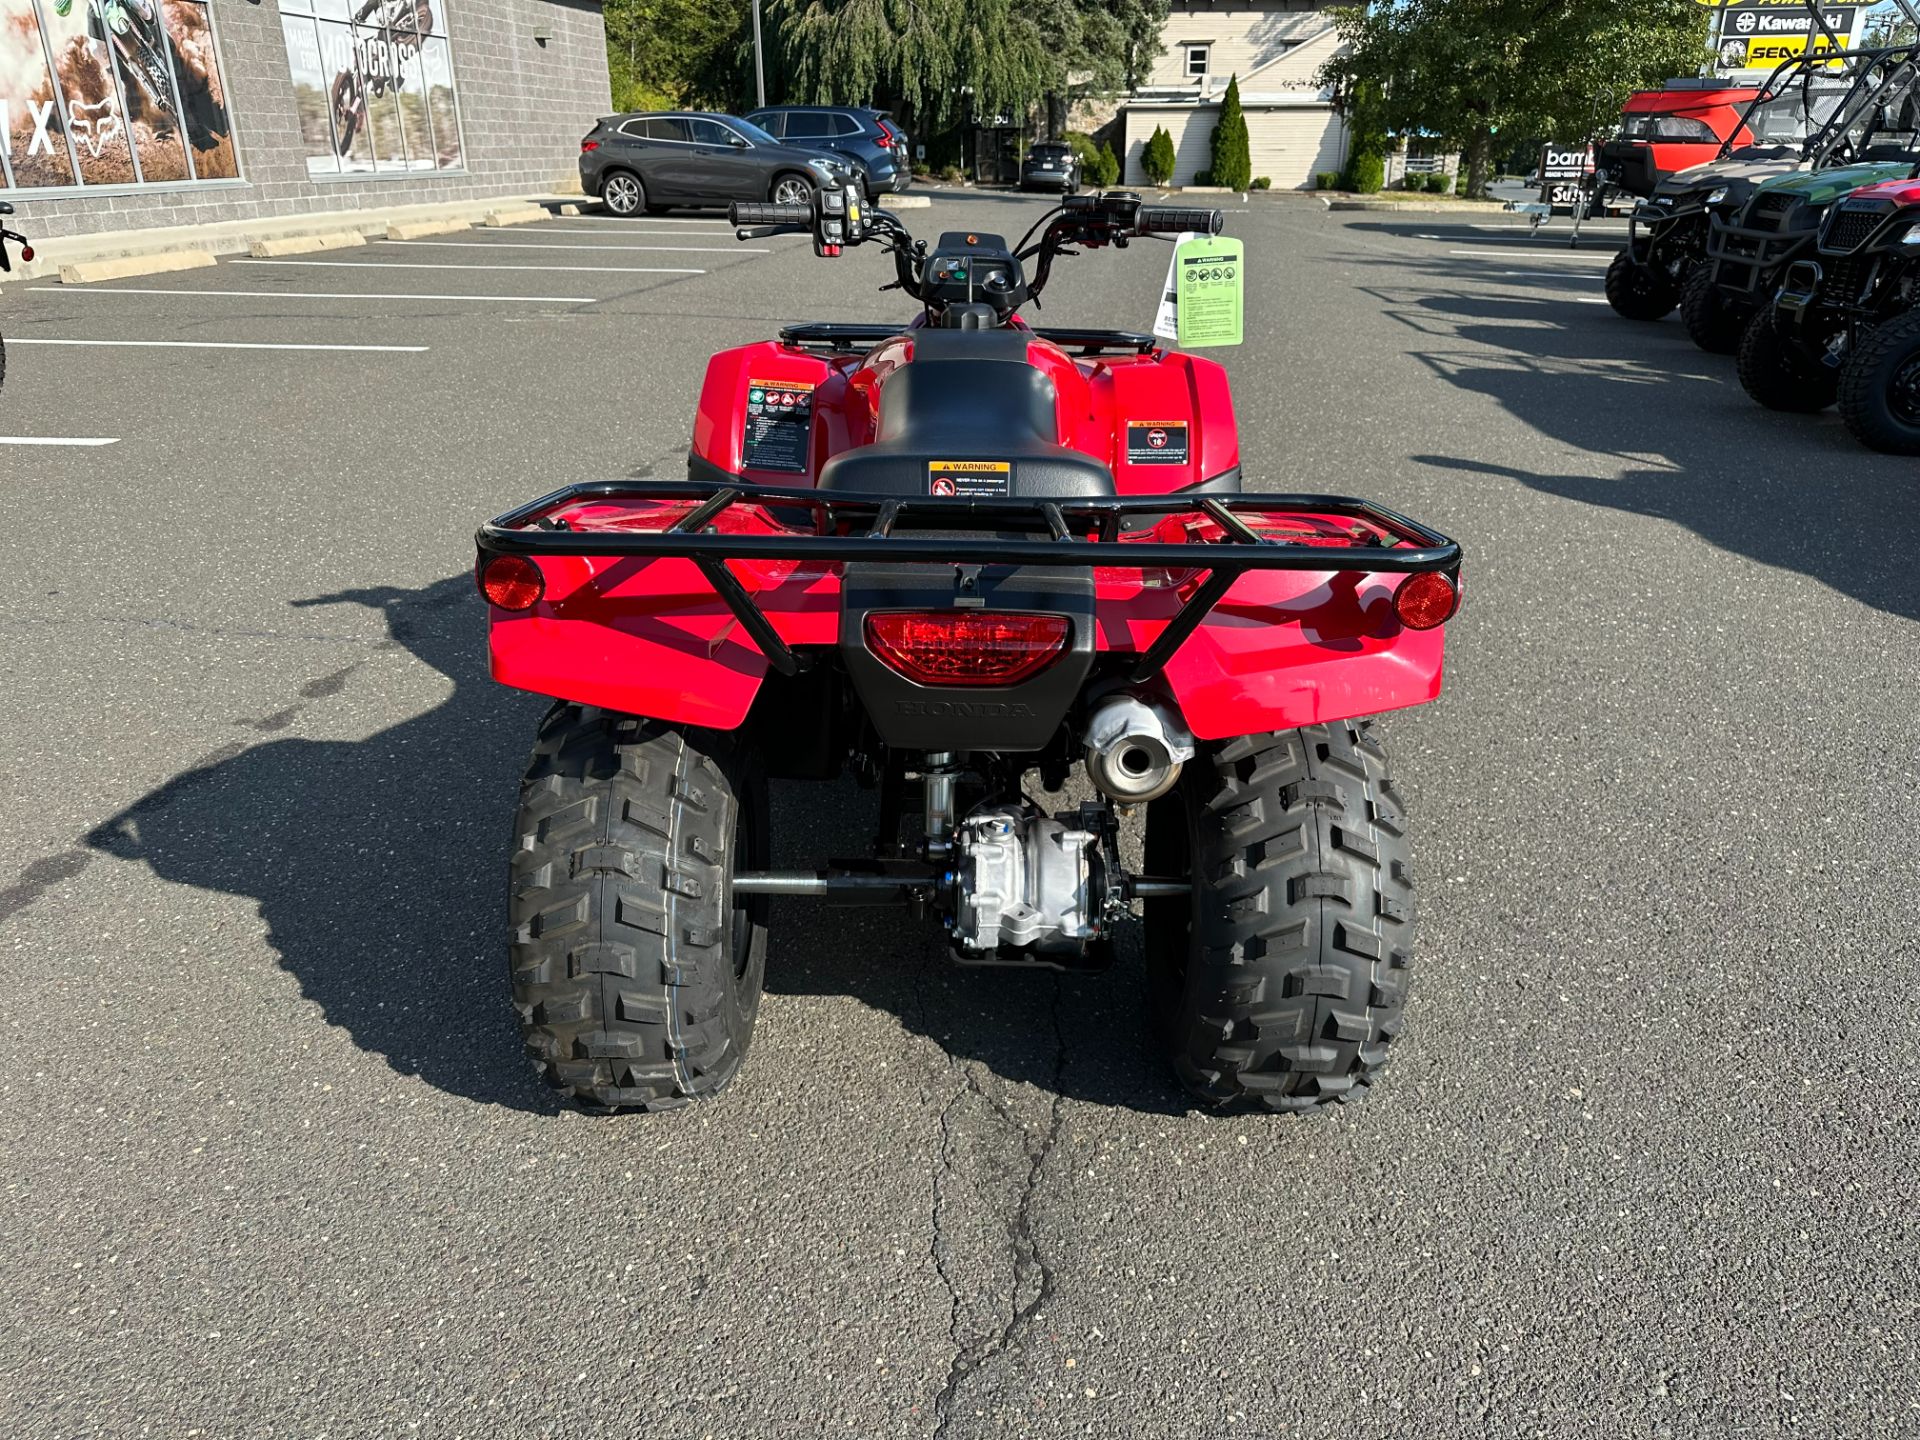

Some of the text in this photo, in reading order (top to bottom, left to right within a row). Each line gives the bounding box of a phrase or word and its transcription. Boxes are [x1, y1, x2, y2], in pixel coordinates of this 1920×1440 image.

[1758, 14, 1842, 31] Kawaski
[289, 28, 315, 49] MADE
[301, 33, 421, 79] FOR MOTOCROSS
[896, 701, 1037, 717] HONDA
